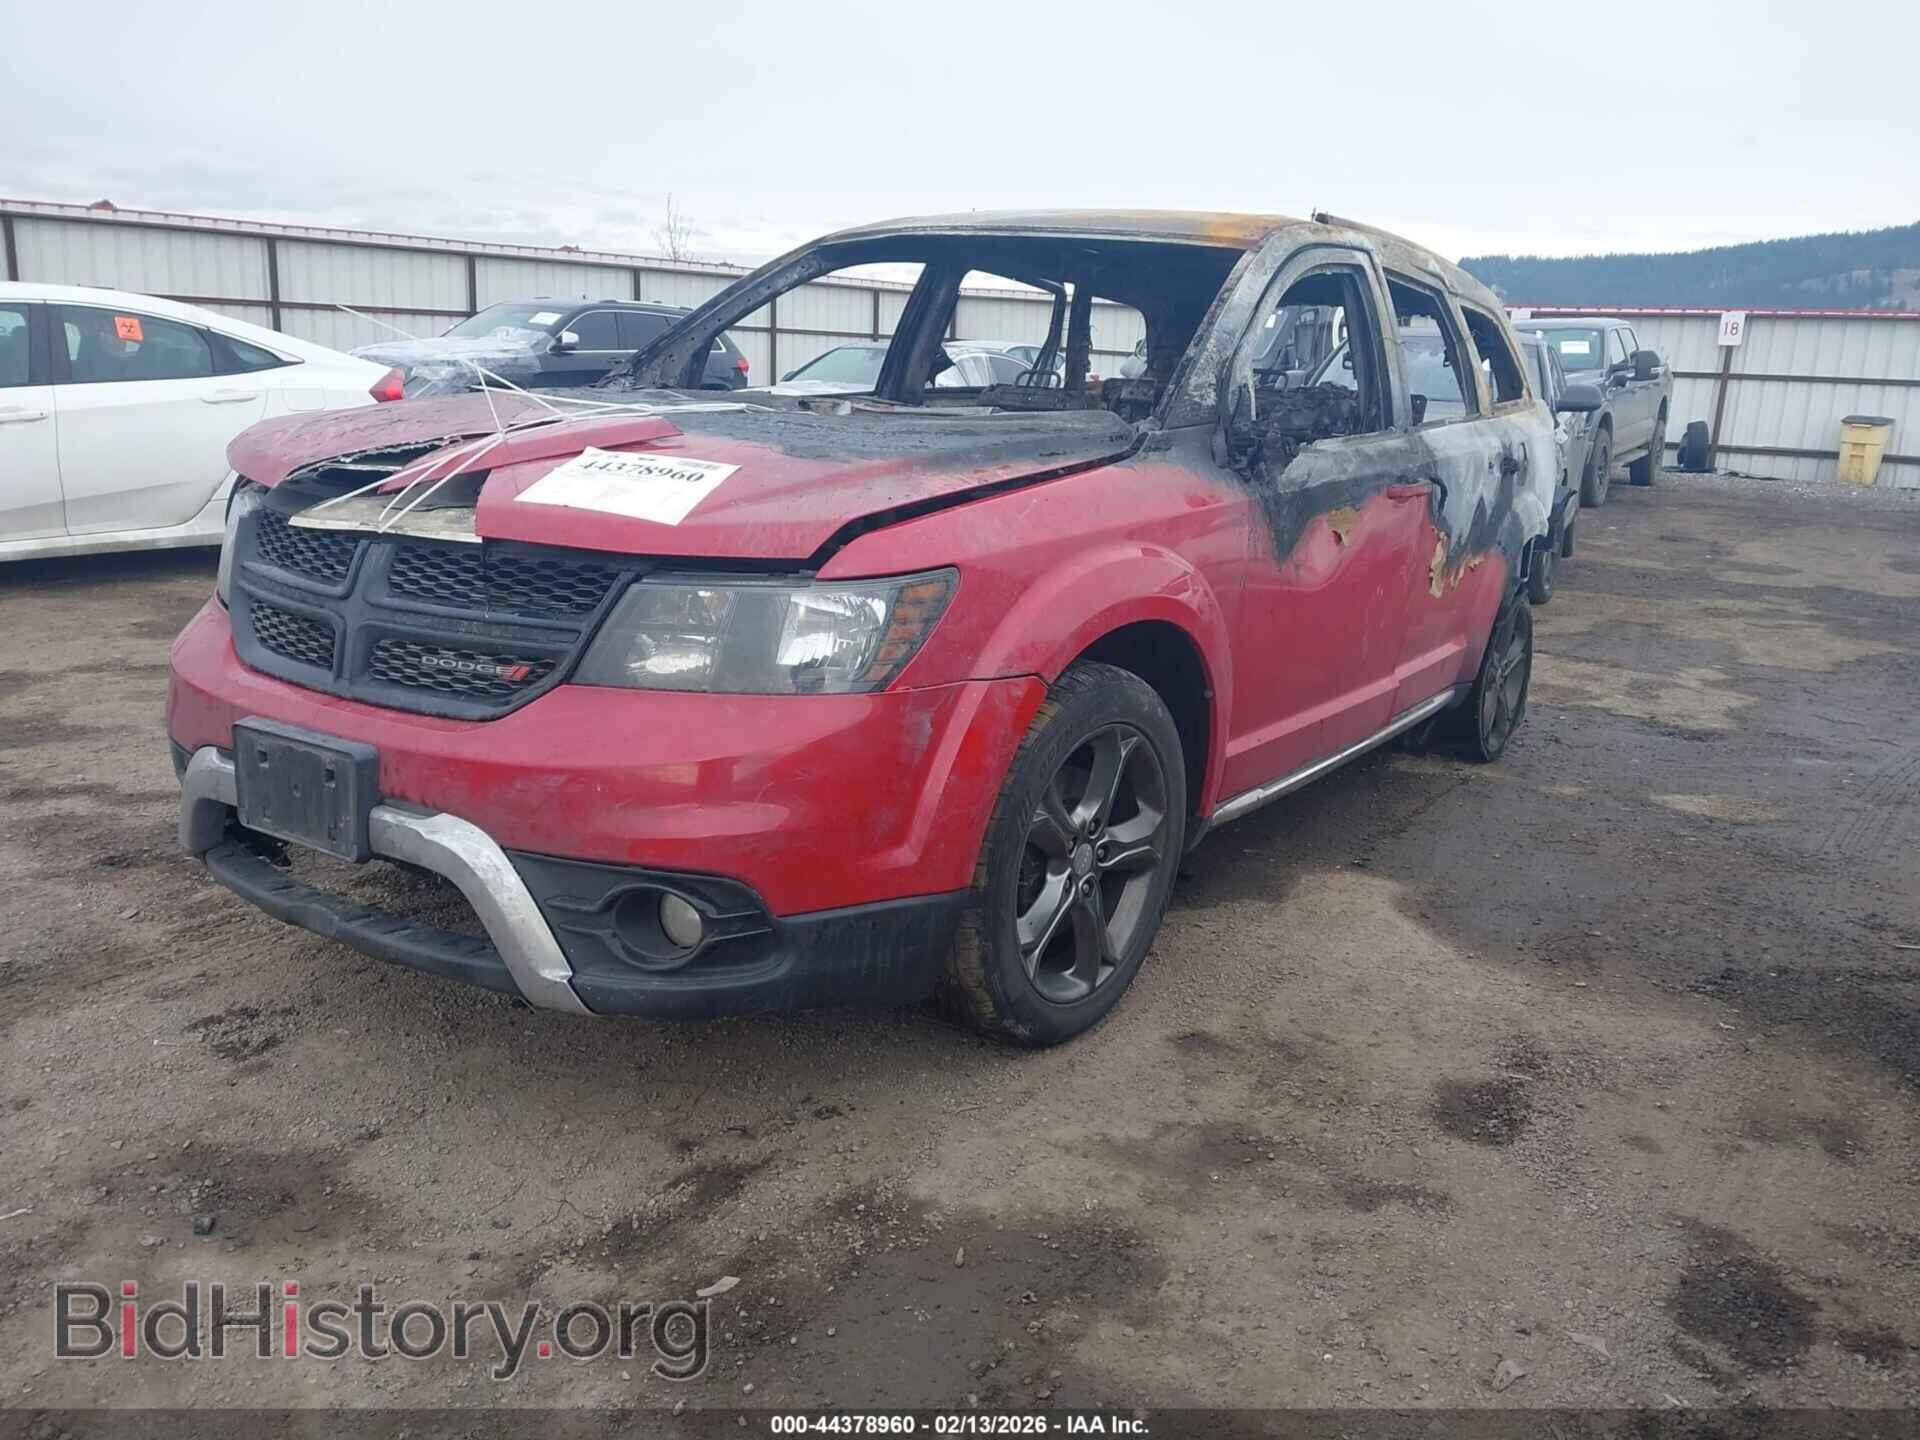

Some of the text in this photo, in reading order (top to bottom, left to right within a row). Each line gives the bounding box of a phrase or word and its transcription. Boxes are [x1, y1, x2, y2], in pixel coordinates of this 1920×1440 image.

[1724, 321, 1740, 337] 18
[579, 460, 705, 482] 44378960
[421, 655, 513, 676] DODGE
